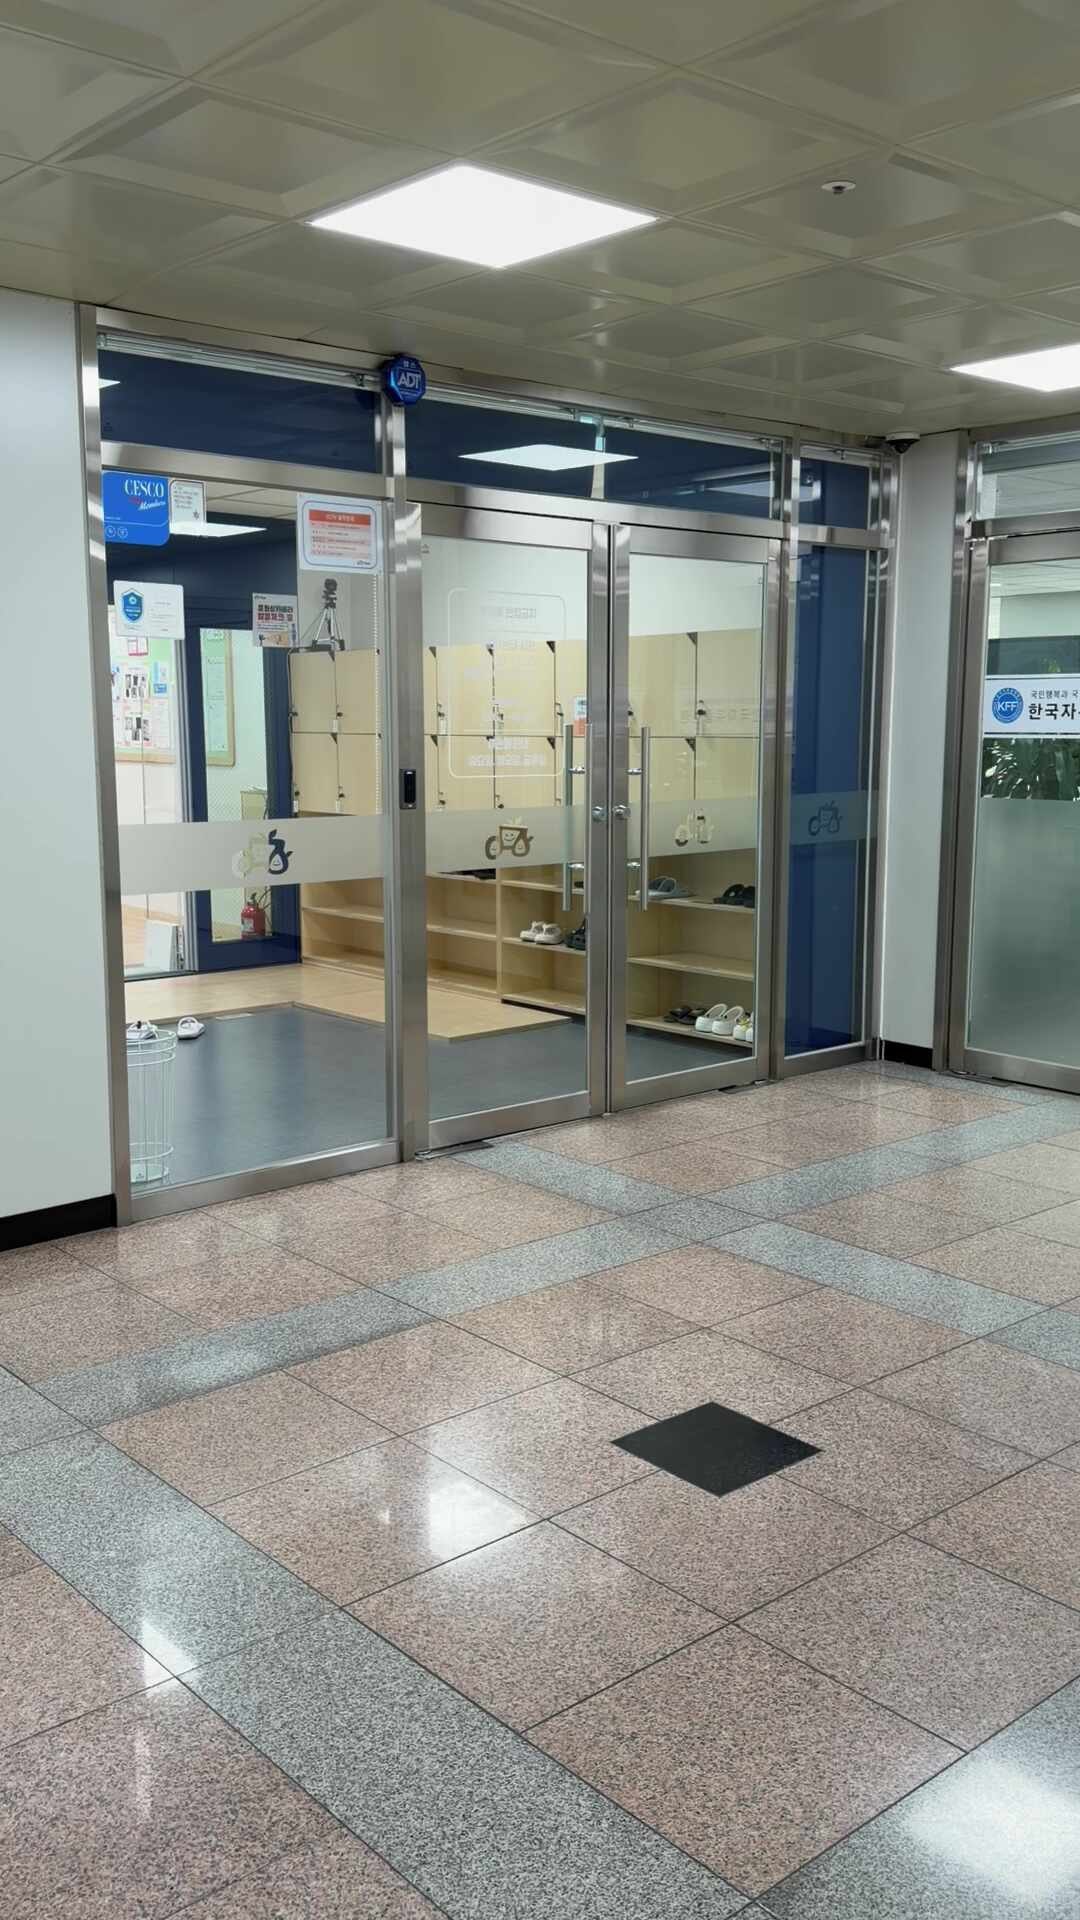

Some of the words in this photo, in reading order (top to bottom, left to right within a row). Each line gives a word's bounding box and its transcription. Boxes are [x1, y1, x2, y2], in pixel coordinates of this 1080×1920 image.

[397, 371, 421, 389] ADT
[124, 479, 165, 498] CESCO
[997, 701, 1018, 712] KFF
[1028, 703, 1080, 720] 한국자
